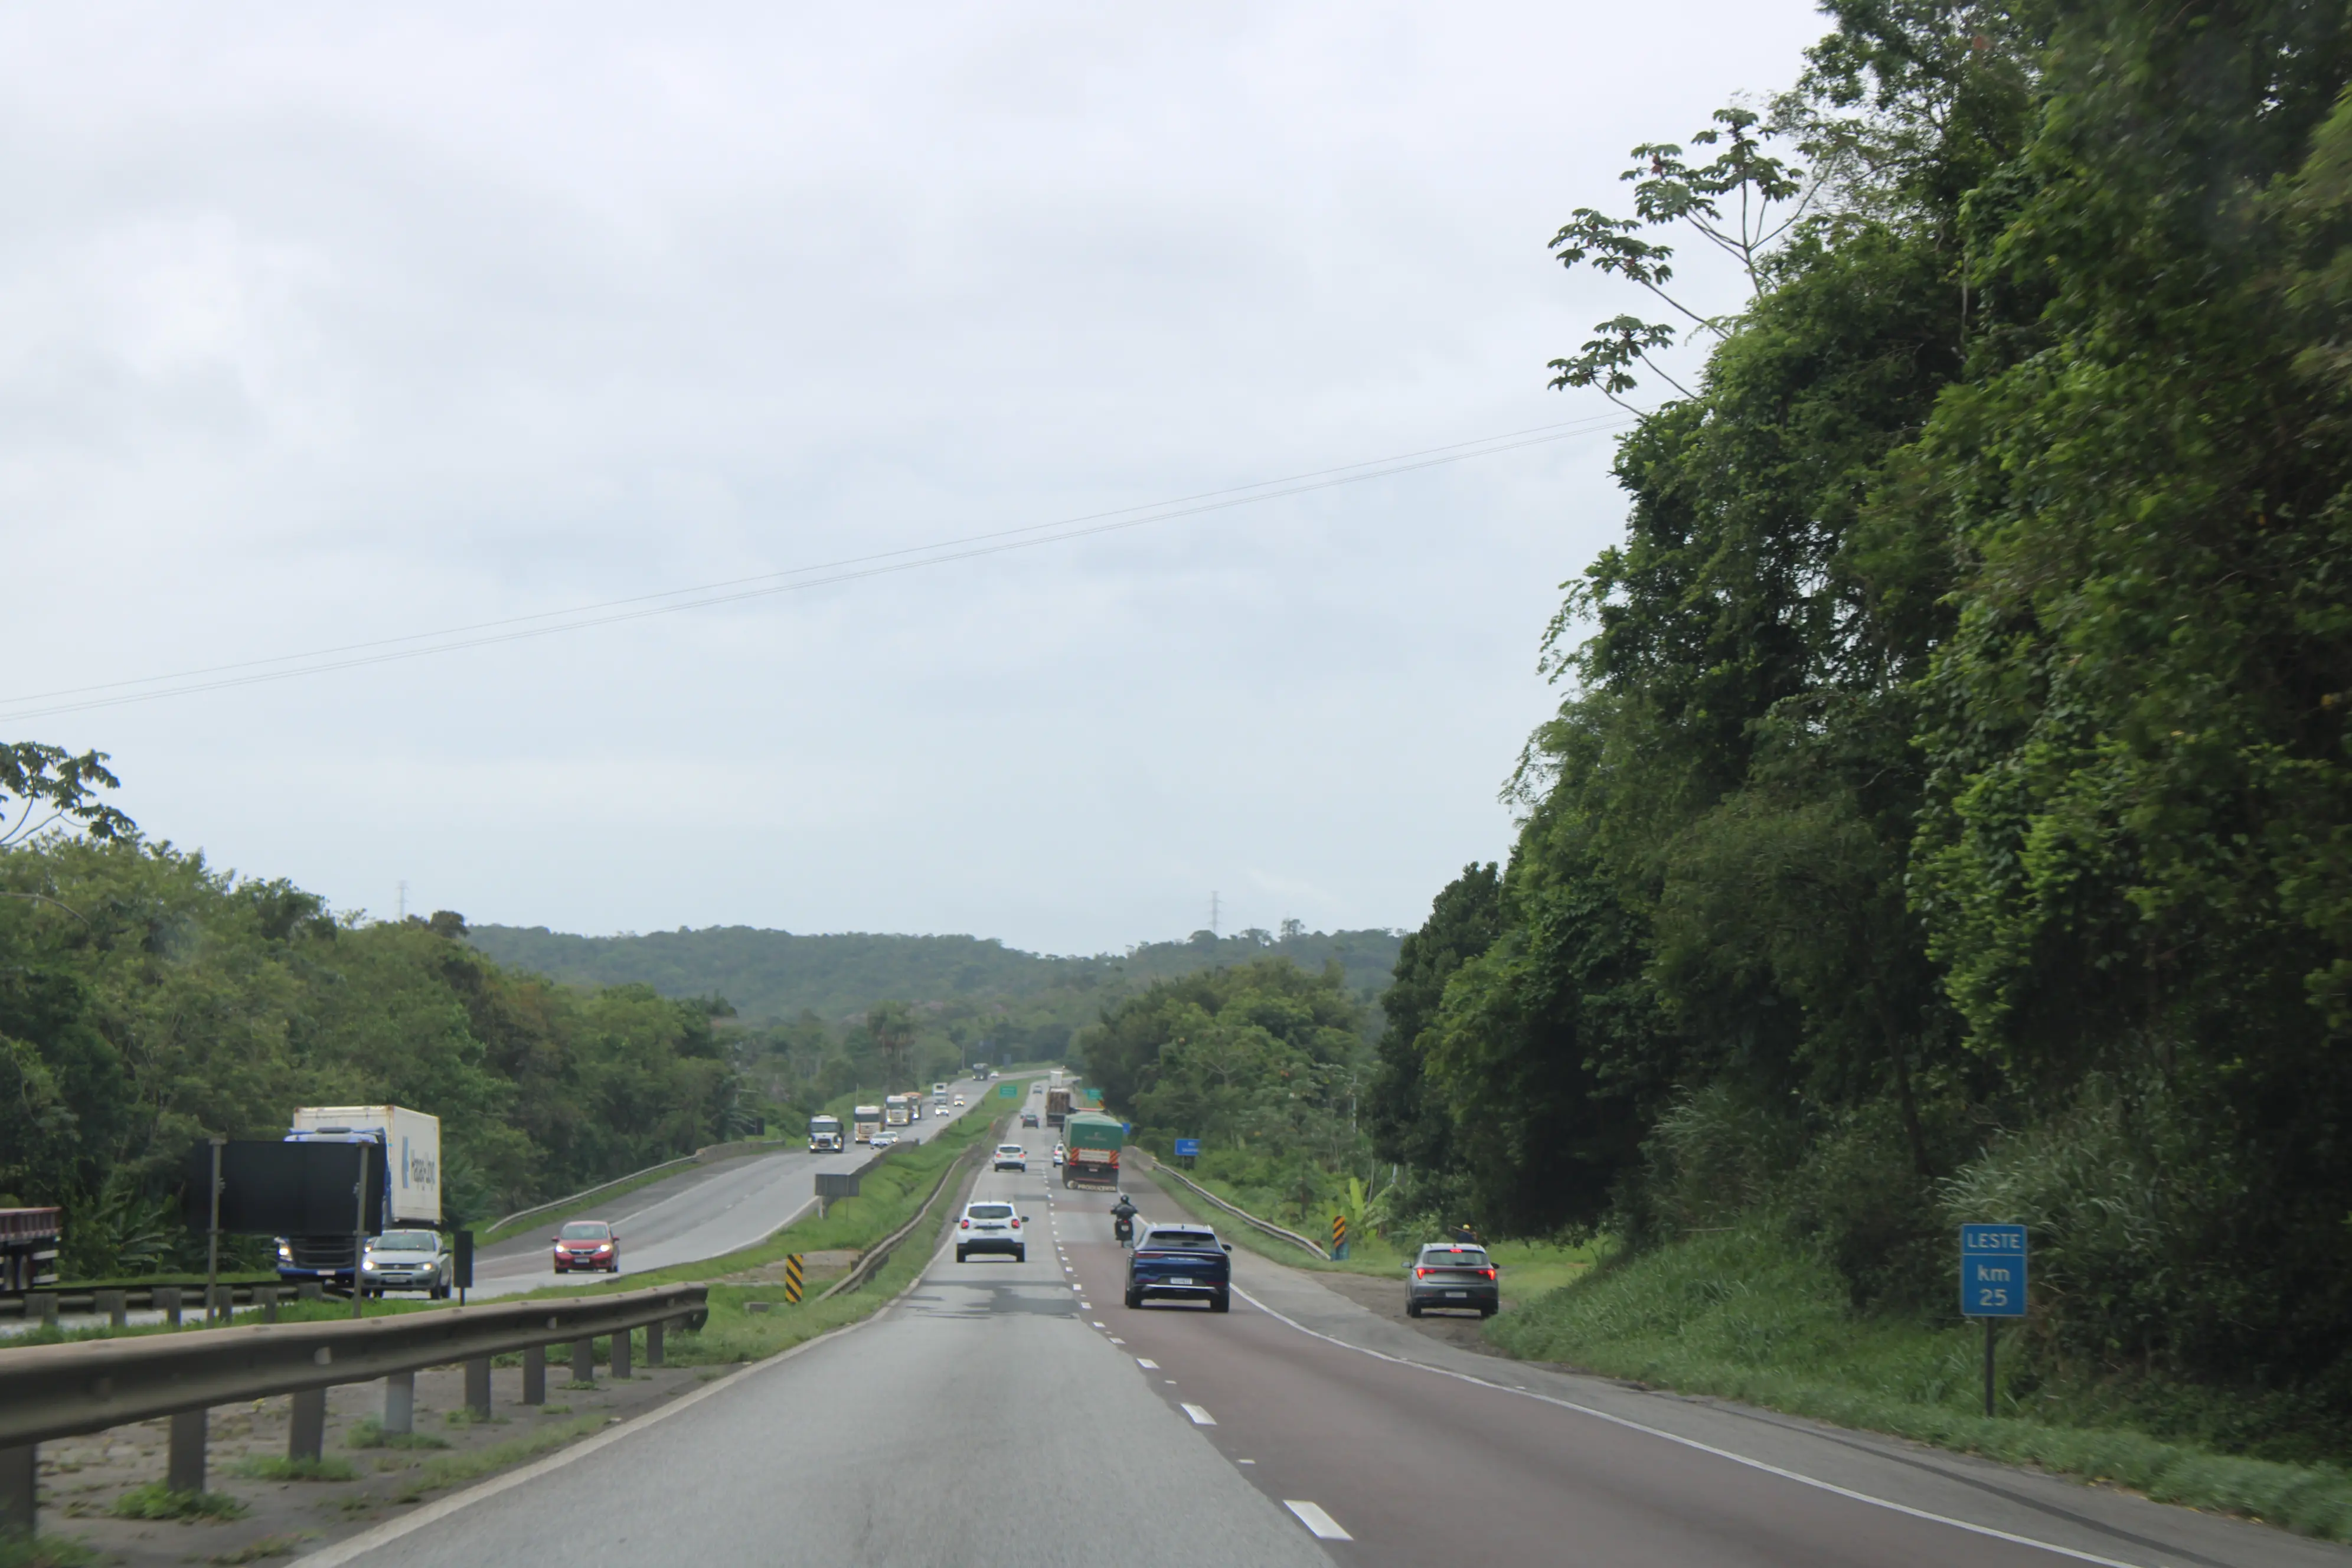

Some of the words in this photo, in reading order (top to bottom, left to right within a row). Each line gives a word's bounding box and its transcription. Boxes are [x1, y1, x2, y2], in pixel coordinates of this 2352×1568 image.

[1967, 1233, 2021, 1249] LESTE
[1977, 1264, 2011, 1282] km
[1979, 1288, 2008, 1306] 25
